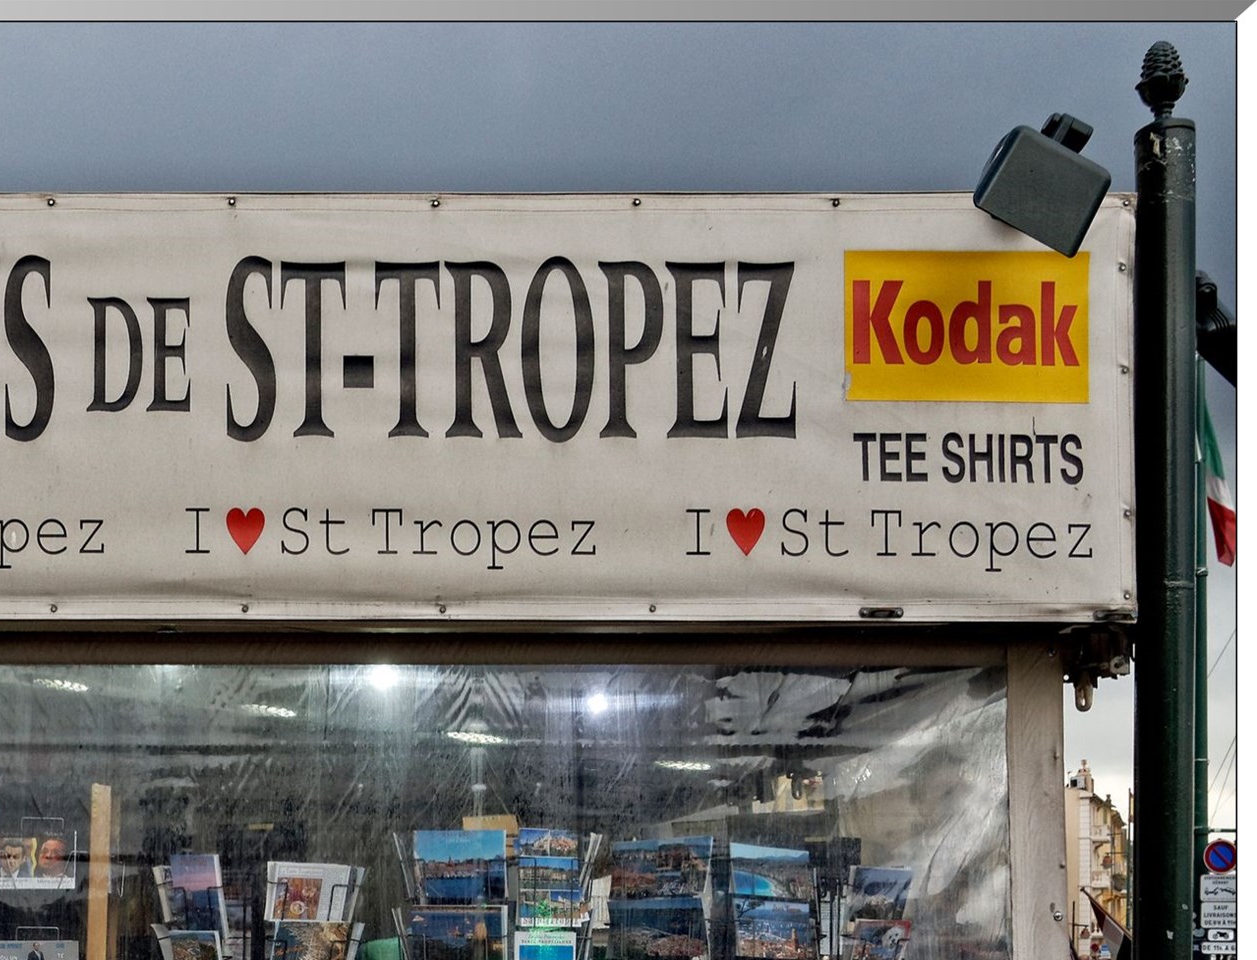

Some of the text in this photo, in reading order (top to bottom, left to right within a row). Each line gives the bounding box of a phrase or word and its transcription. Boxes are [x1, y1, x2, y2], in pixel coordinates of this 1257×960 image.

[86, 296, 191, 413] DE
[226, 255, 797, 443] ST-TROPEZ
[852, 280, 1080, 367] Kodak
[853, 432, 1083, 485] TEE SHIRTS
[185, 506, 598, 570] I St Tropez
[685, 508, 1093, 572] I St Tropez
